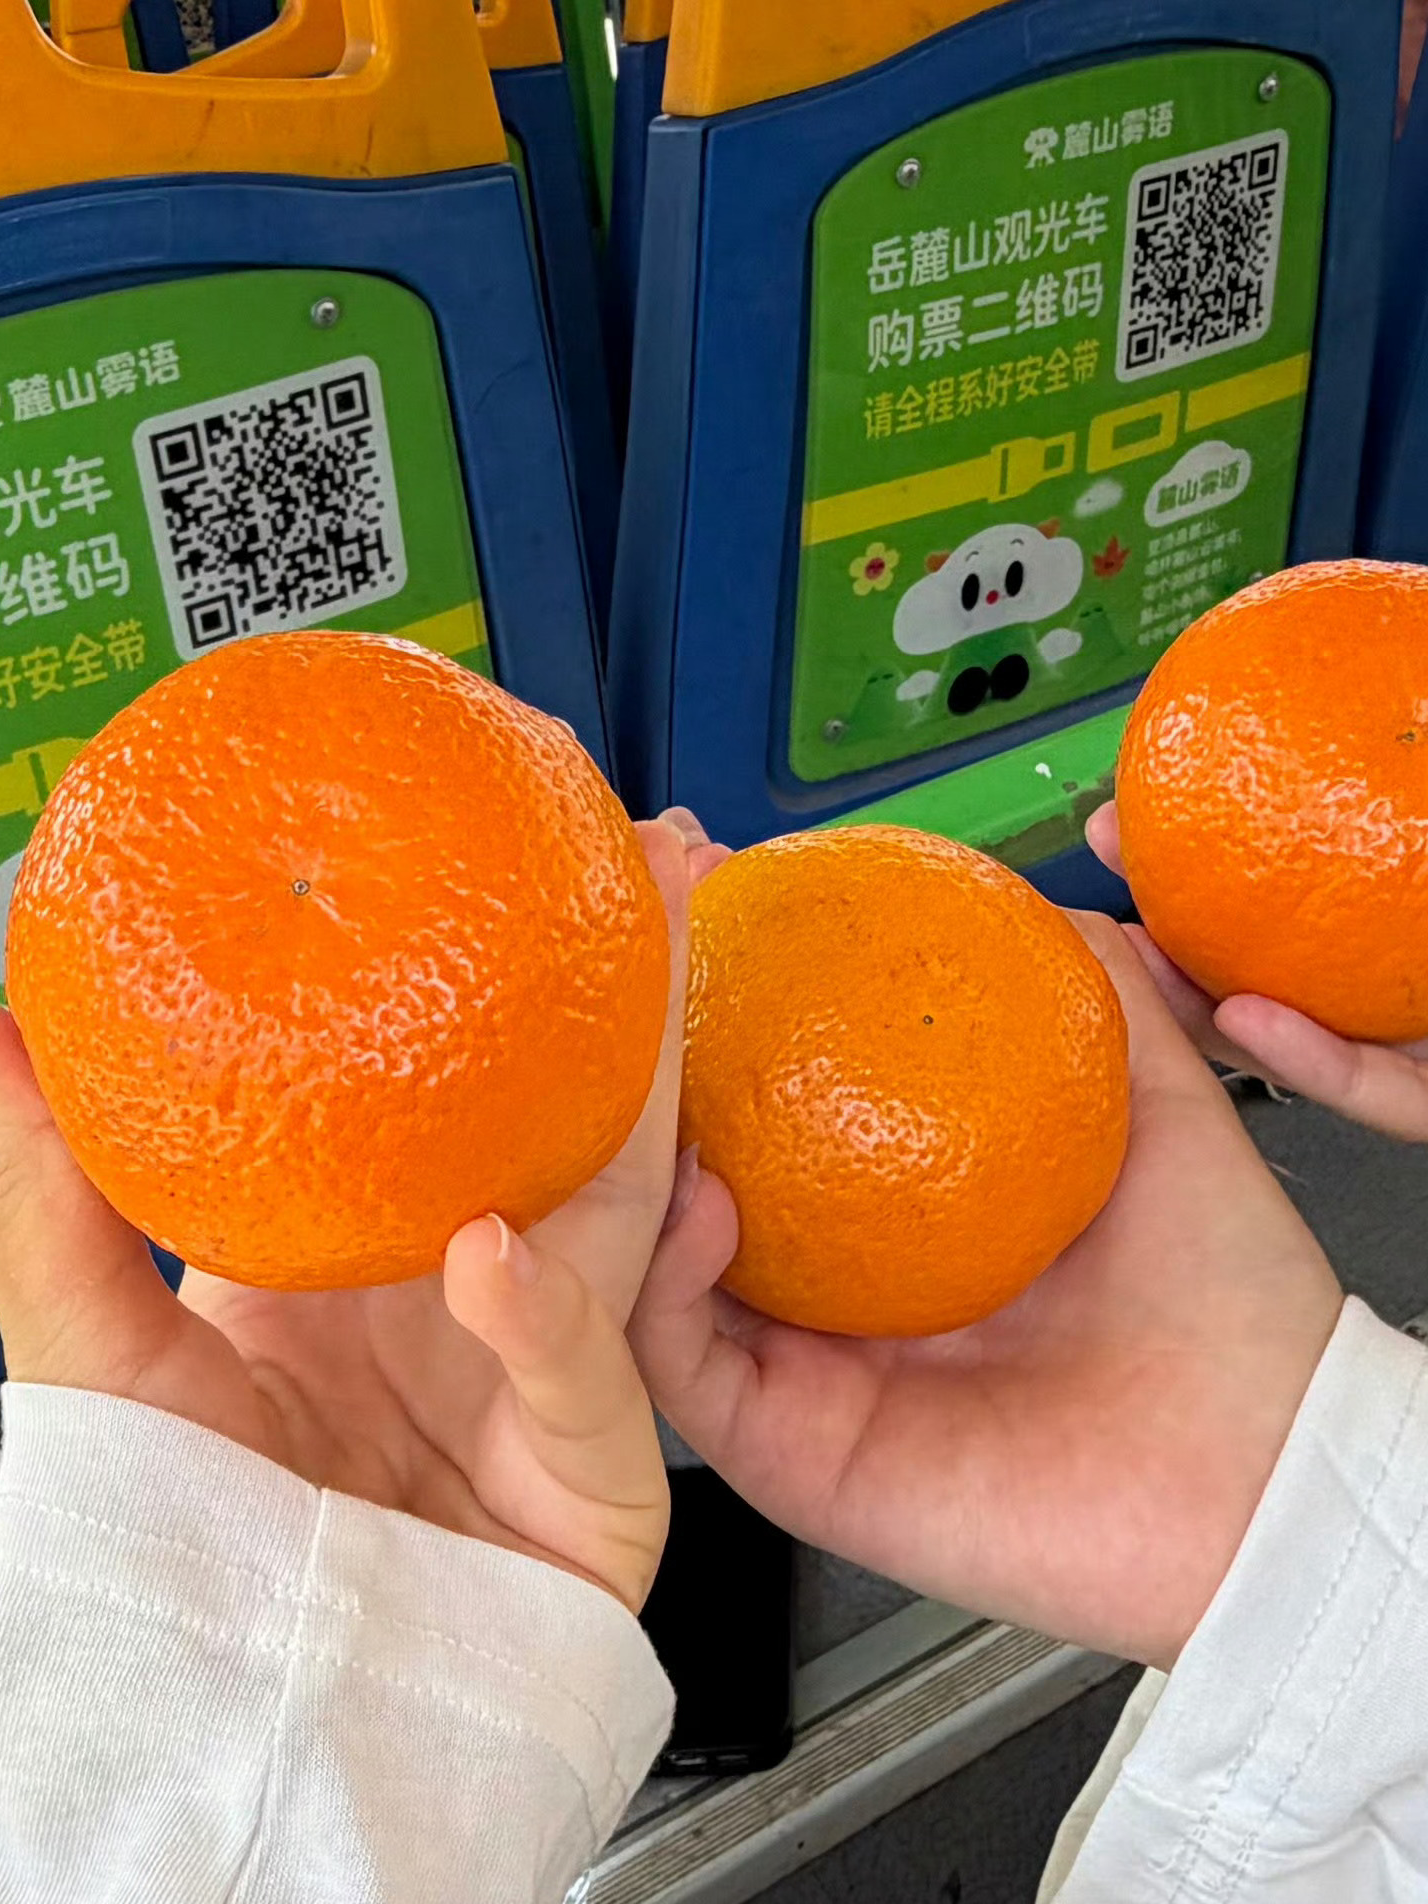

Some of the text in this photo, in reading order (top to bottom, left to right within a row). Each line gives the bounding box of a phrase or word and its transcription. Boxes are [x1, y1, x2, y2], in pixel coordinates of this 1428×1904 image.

[867, 192, 1110, 295] 岳麓山观光车
[868, 261, 1105, 374] 购票二维码
[7, 339, 181, 422] 麓山雾语
[864, 338, 1100, 440] 请全程系好安全带
